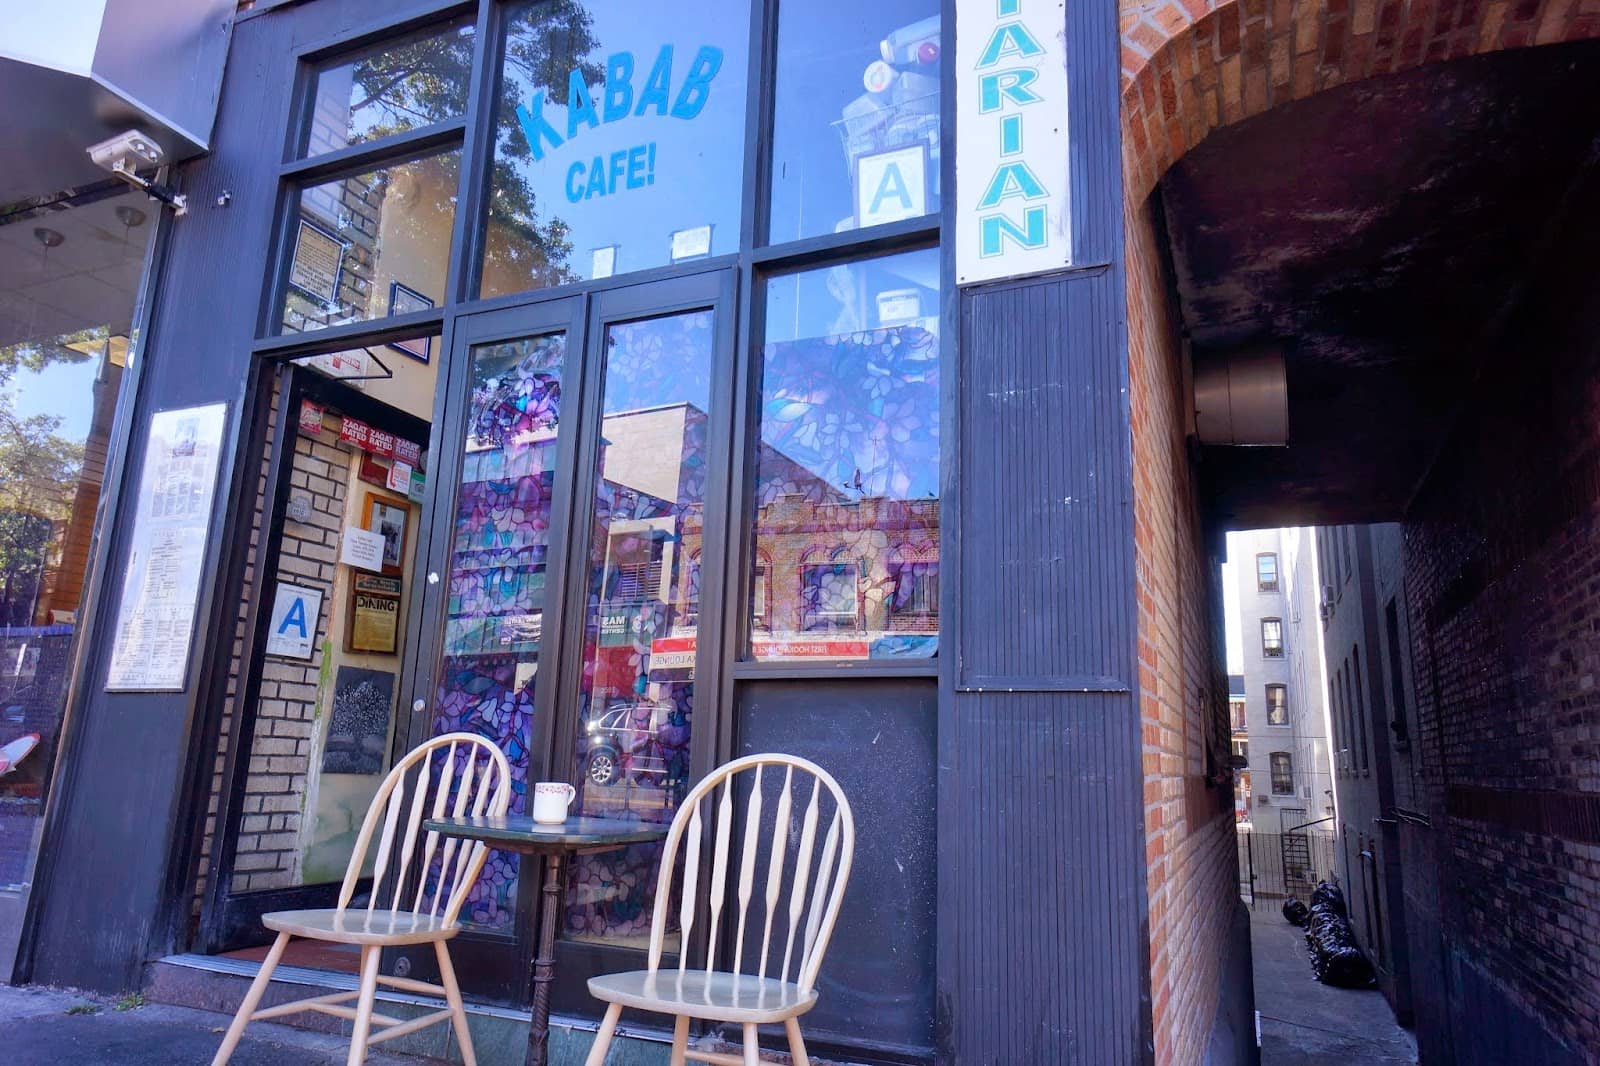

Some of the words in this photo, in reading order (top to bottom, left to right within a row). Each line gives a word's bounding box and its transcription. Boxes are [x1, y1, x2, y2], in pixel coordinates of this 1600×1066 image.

[515, 43, 724, 161] KABAB
[565, 142, 657, 203] CAFE!
[868, 161, 913, 214] A
[342, 426, 367, 442] RATED
[343, 418, 367, 434] ZAGAT
[369, 437, 393, 451] RATED
[370, 429, 394, 443] ZAGAT
[357, 597, 395, 612] DINING
[277, 595, 307, 639] A
